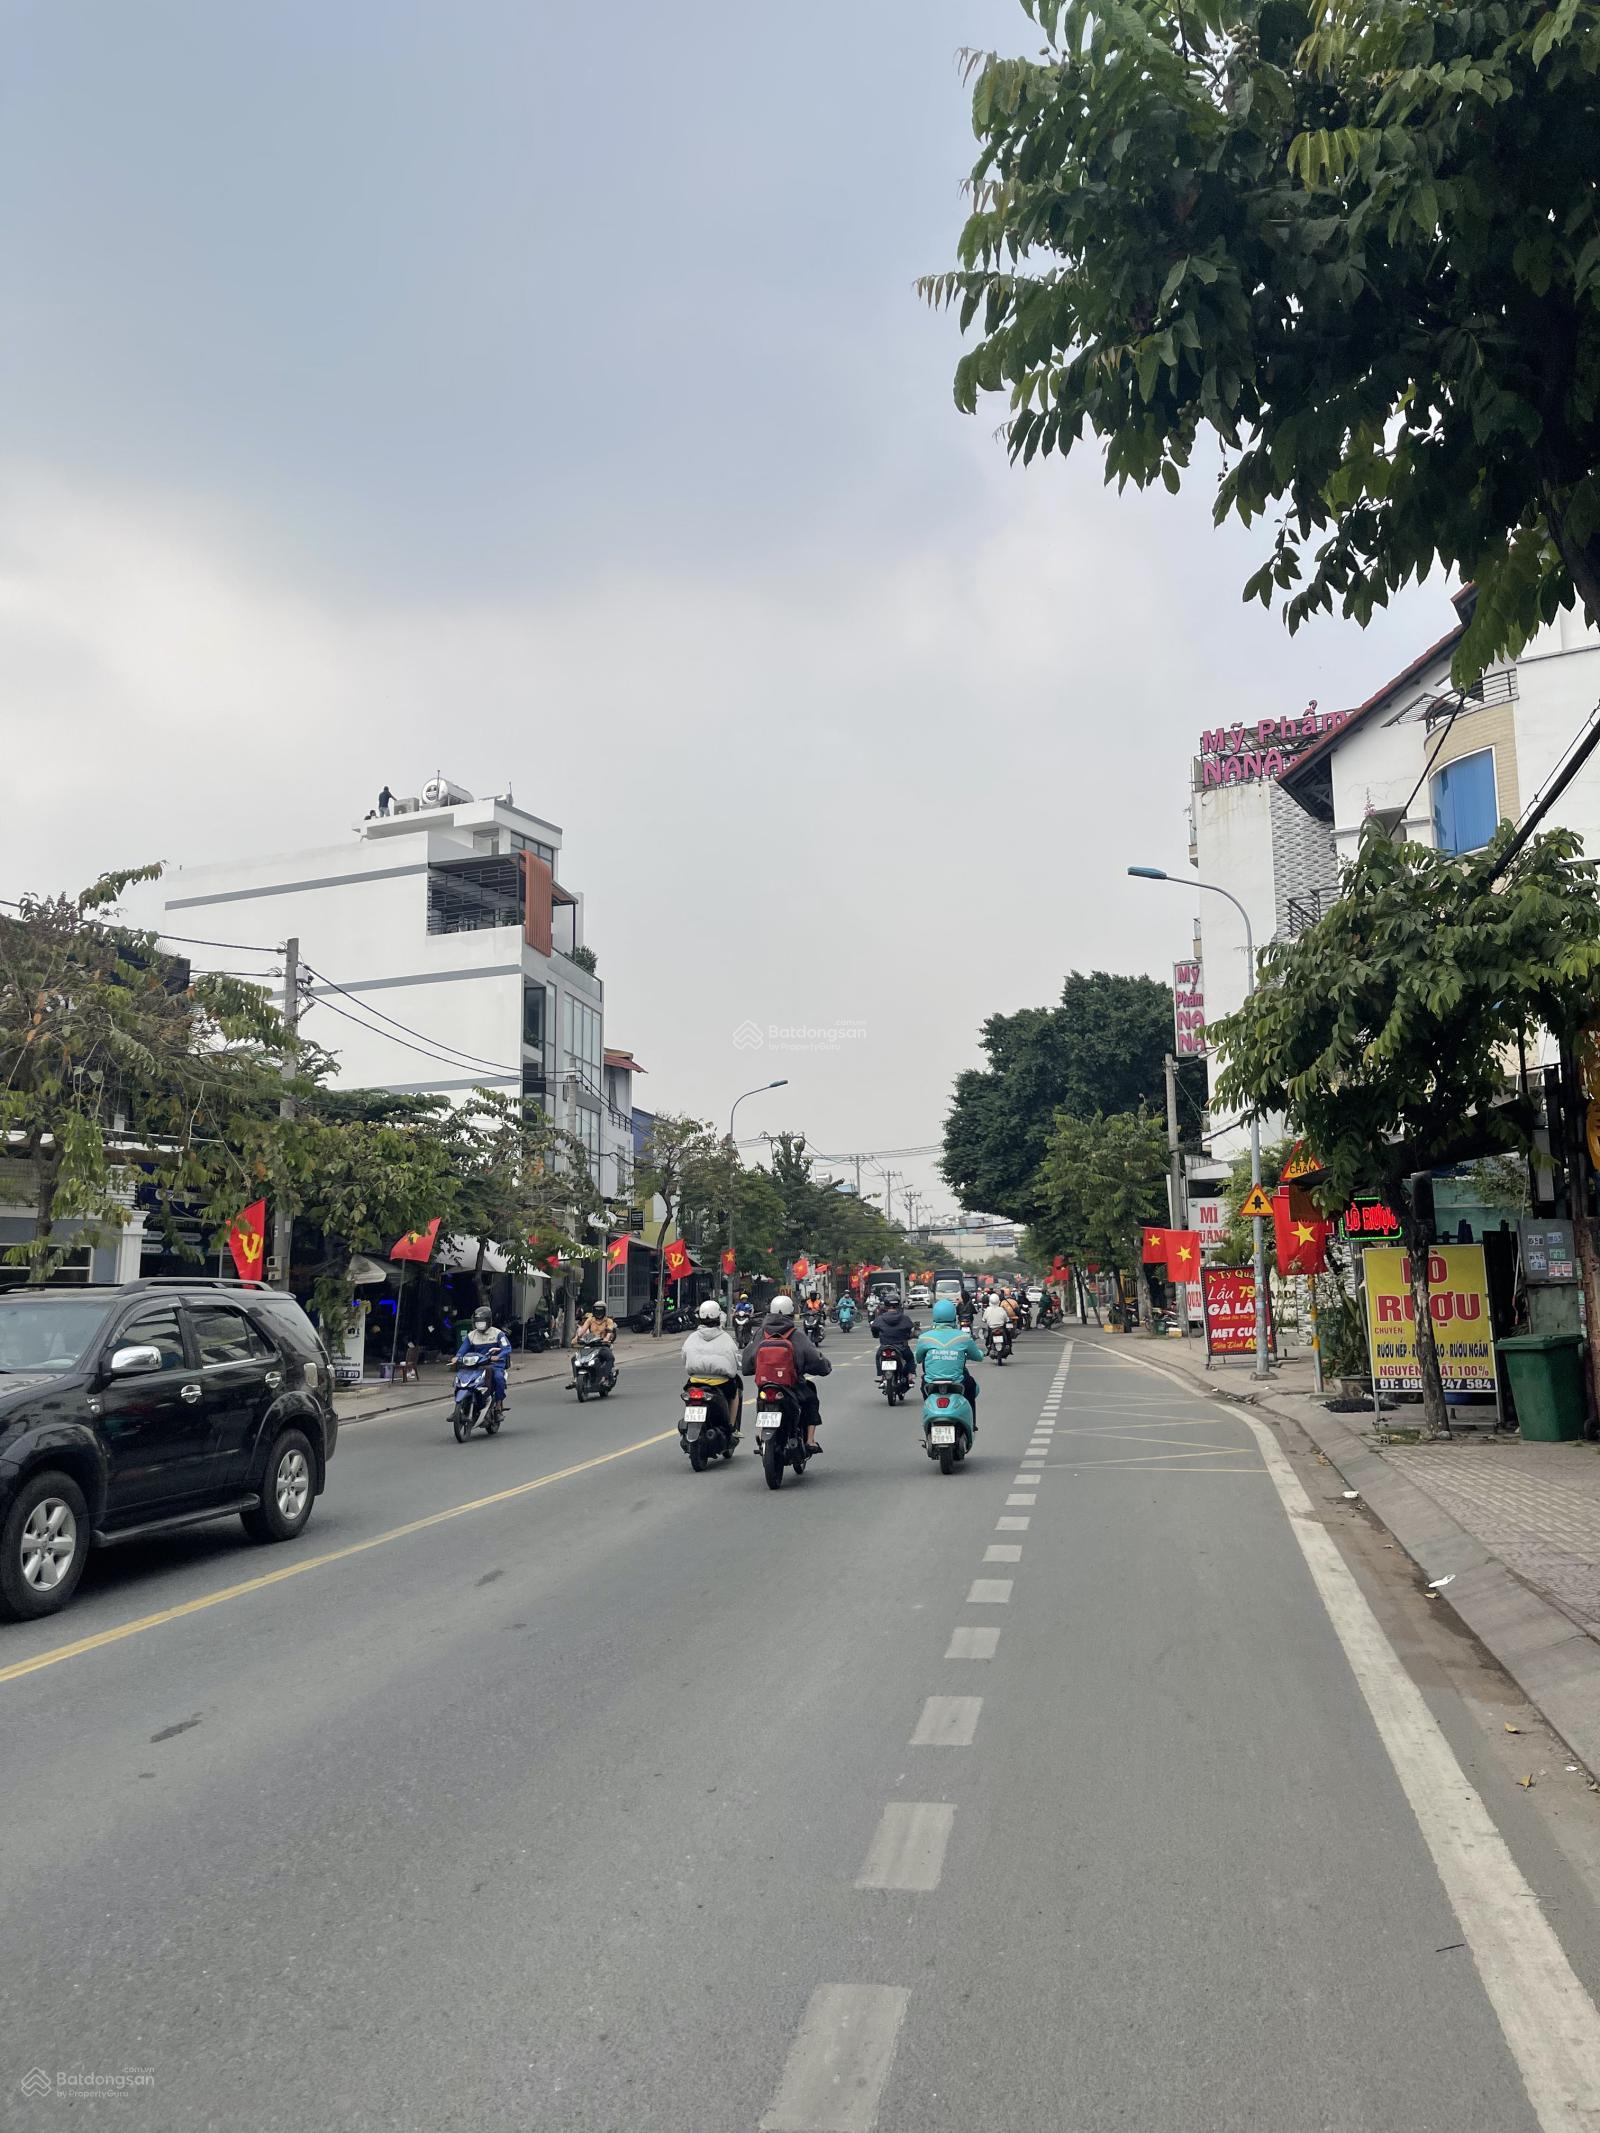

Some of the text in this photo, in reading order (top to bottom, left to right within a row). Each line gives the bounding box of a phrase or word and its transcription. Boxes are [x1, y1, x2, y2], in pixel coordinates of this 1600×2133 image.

[1202, 700, 1347, 753] Mỹ Phẩm
[1203, 748, 1282, 785] NANA
[1177, 965, 1200, 985] Mỹ
[1177, 1011, 1204, 1030] NA
[1208, 1301, 1231, 1316] GÀ
[1458, 1365, 1489, 1377] 100%
[1466, 1378, 1492, 1389] 584
